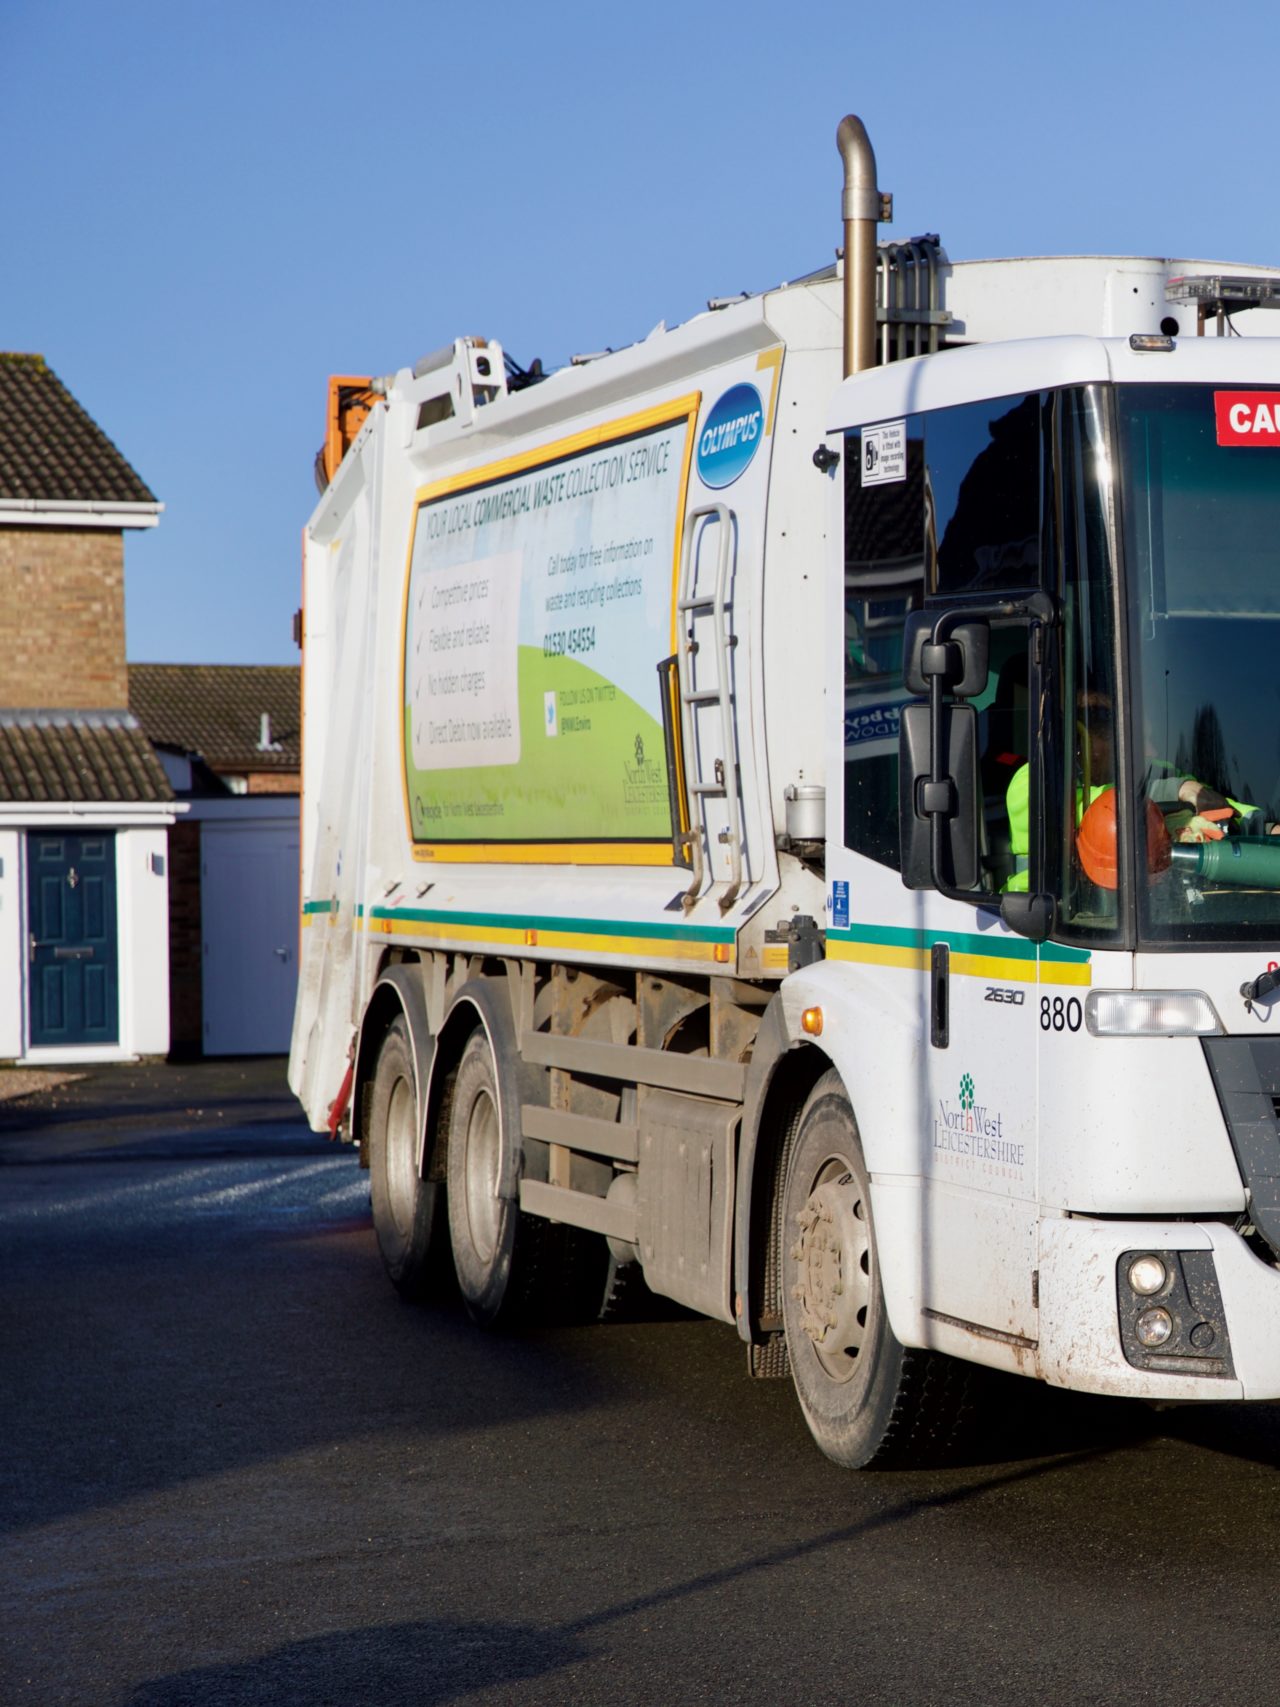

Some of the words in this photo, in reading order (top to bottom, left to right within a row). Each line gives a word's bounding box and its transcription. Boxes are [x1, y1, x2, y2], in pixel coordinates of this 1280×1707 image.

[701, 410, 760, 457] OLYMPUS
[448, 503, 473, 533] LOCAL
[474, 483, 531, 526] COMMERCIAL
[533, 473, 566, 509] WASTE
[566, 453, 628, 499] COLLECTION
[627, 440, 671, 482] SERVICE
[603, 538, 642, 564] information
[606, 577, 642, 600] collections
[543, 631, 566, 658] 01530
[984, 986, 1025, 1006] 2630
[1040, 995, 1083, 1033] 880
[934, 1119, 1024, 1166] LEICESTERSHIRE
